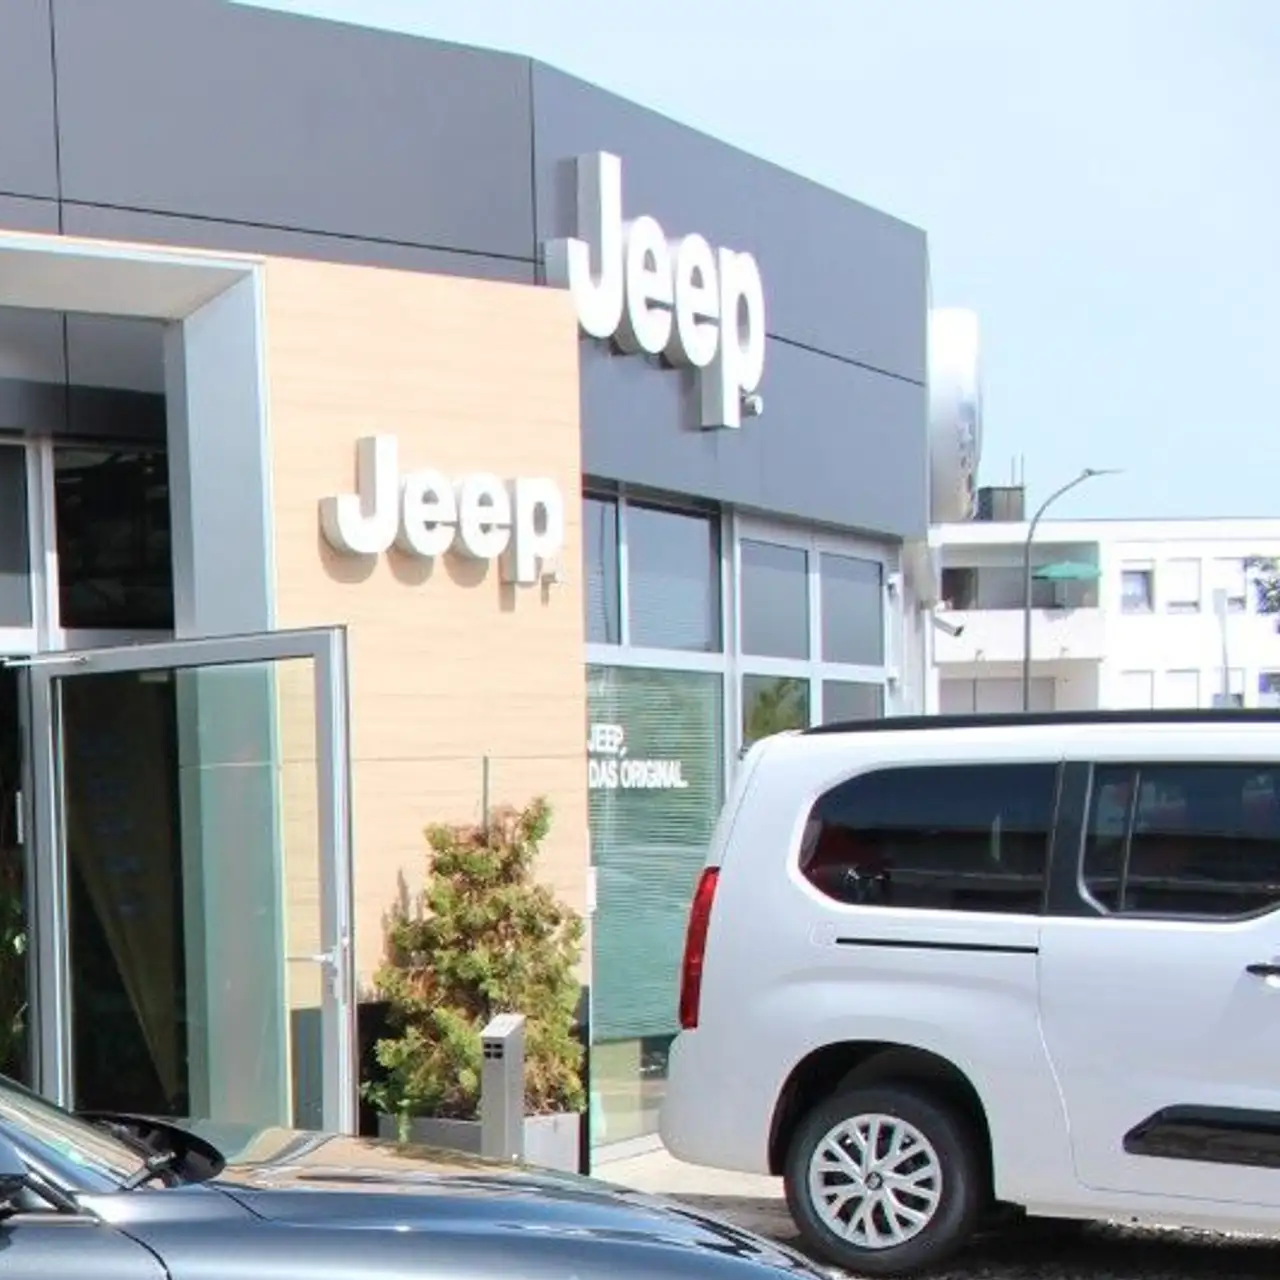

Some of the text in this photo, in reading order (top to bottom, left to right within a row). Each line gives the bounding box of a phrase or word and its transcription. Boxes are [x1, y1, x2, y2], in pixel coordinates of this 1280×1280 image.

[548, 150, 765, 429] Jeep
[320, 433, 563, 583] Jeep
[588, 760, 619, 788] DAS
